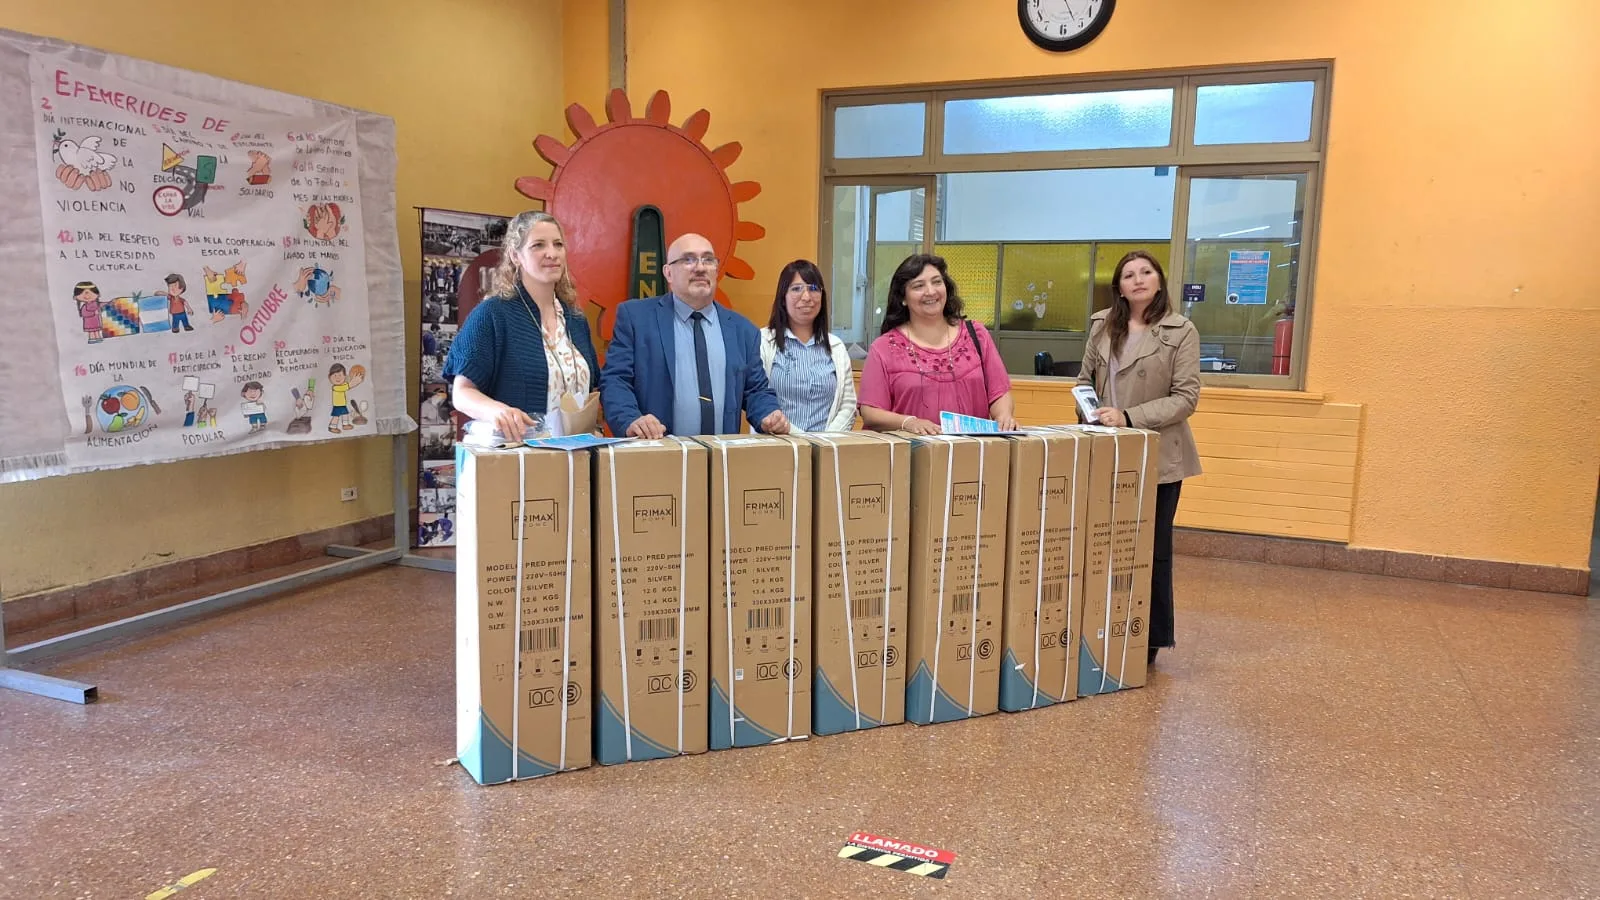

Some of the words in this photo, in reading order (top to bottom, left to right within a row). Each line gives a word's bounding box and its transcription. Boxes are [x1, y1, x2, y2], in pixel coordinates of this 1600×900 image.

[41, 97, 52, 110] 2
[55, 69, 187, 123] EFEMERIDES
[202, 116, 230, 132] DE
[60, 116, 147, 136] INTERNACIONAL
[113, 138, 127, 147] DE
[122, 157, 134, 168] LA
[219, 154, 228, 164] LA
[120, 181, 135, 193] NO
[238, 187, 274, 199] SOLIDARIO
[293, 193, 308, 202] MES
[57, 200, 127, 213] VIOLENCIA
[99, 232, 113, 241] DEL
[120, 232, 160, 247] RESPETO
[60, 250, 67, 260] A
[75, 250, 88, 258] LA
[94, 249, 156, 260] DIVERSIDAD
[201, 248, 240, 257] ESCOLAR
[308, 251, 317, 259] DE
[88, 263, 144, 272] CULTURAL
[239, 283, 288, 345] OCTUBRE
[195, 352, 203, 360] DE
[207, 349, 216, 358] LA
[108, 360, 147, 371] MUNDIAL
[148, 359, 157, 368] DE
[289, 357, 298, 365] LA
[232, 365, 238, 373] A
[242, 363, 253, 372] LA
[113, 374, 123, 382] LA
[233, 370, 272, 384] IDENTIDAD
[182, 430, 226, 446] POPULAR
[850, 496, 881, 505] FRIMAX
[954, 494, 979, 502] FRIMA
[745, 501, 780, 510] FRIMAX
[635, 509, 672, 518] FRIMAX
[610, 555, 643, 563] MDELO
[646, 553, 666, 561] PRED
[525, 560, 546, 568] PRED
[487, 575, 517, 583] POWER
[611, 578, 637, 586] CLOR
[647, 575, 673, 583] SILVER
[487, 587, 516, 595] COLOR
[526, 583, 555, 591] SILVER
[661, 585, 677, 593] KGS
[543, 605, 560, 613] KGS
[488, 623, 506, 631] SIZE
[1042, 634, 1057, 648] QC
[859, 652, 878, 666] QC
[759, 664, 779, 678] QC
[650, 675, 672, 691] QC
[532, 689, 555, 705] QC
[852, 833, 939, 858] LLAMADO
